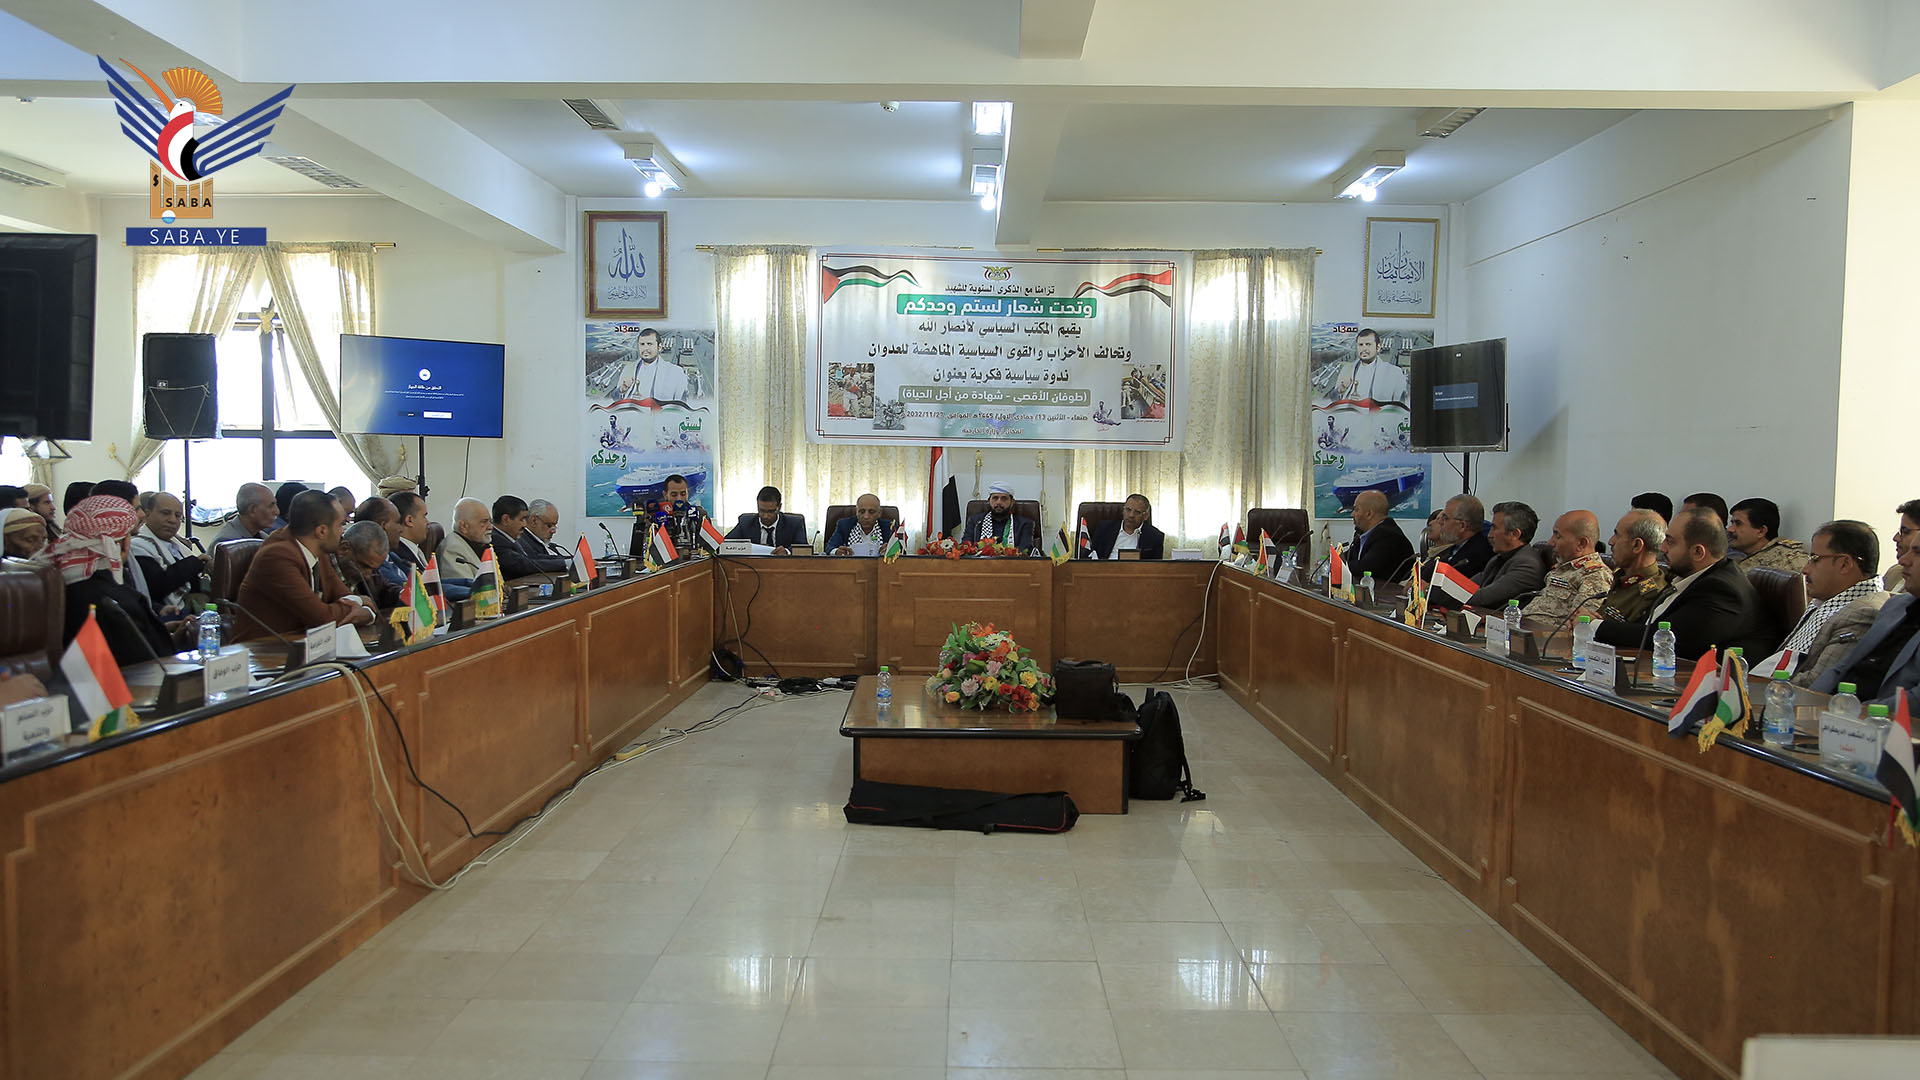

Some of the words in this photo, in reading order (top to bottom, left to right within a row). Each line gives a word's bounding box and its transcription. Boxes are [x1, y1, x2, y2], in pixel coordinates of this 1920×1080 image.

[944, 283, 967, 293] للشهيد
[968, 284, 995, 294] السنوية
[997, 284, 1022, 295] الذكرى
[1024, 286, 1033, 296] مع
[1034, 285, 1055, 296] تزامنا
[903, 297, 957, 315] وحدكم
[960, 298, 1002, 316] لستم
[1005, 298, 1044, 317] شعار
[1048, 301, 1093, 318] وتحت
[918, 318, 937, 332] الله
[940, 319, 975, 335] لأنصار
[978, 320, 1020, 338] السياسي
[1023, 321, 1053, 337] المكتب
[1057, 323, 1082, 338] يقيم
[868, 343, 909, 357] للعدوان
[912, 342, 955, 357] المناهضة
[958, 343, 1003, 359] السياسية
[1006, 345, 1043, 361] والقوى
[1046, 344, 1090, 361] الأحزاب
[1094, 345, 1132, 362] وتحالف
[933, 367, 968, 383] بعنوان
[970, 367, 1002, 384] فكرية
[1004, 367, 1041, 384] سياسية
[1043, 368, 1069, 385] ندوة
[902, 388, 933, 400] الحياة)
[934, 387, 952, 401] أجل
[954, 391, 969, 401] من
[971, 388, 1004, 401] شهادة
[1013, 390, 1049, 403] الأقصى
[1051, 391, 1087, 404] (طوفان
[678, 417, 703, 434] لستم
[590, 449, 627, 469] وحدكم
